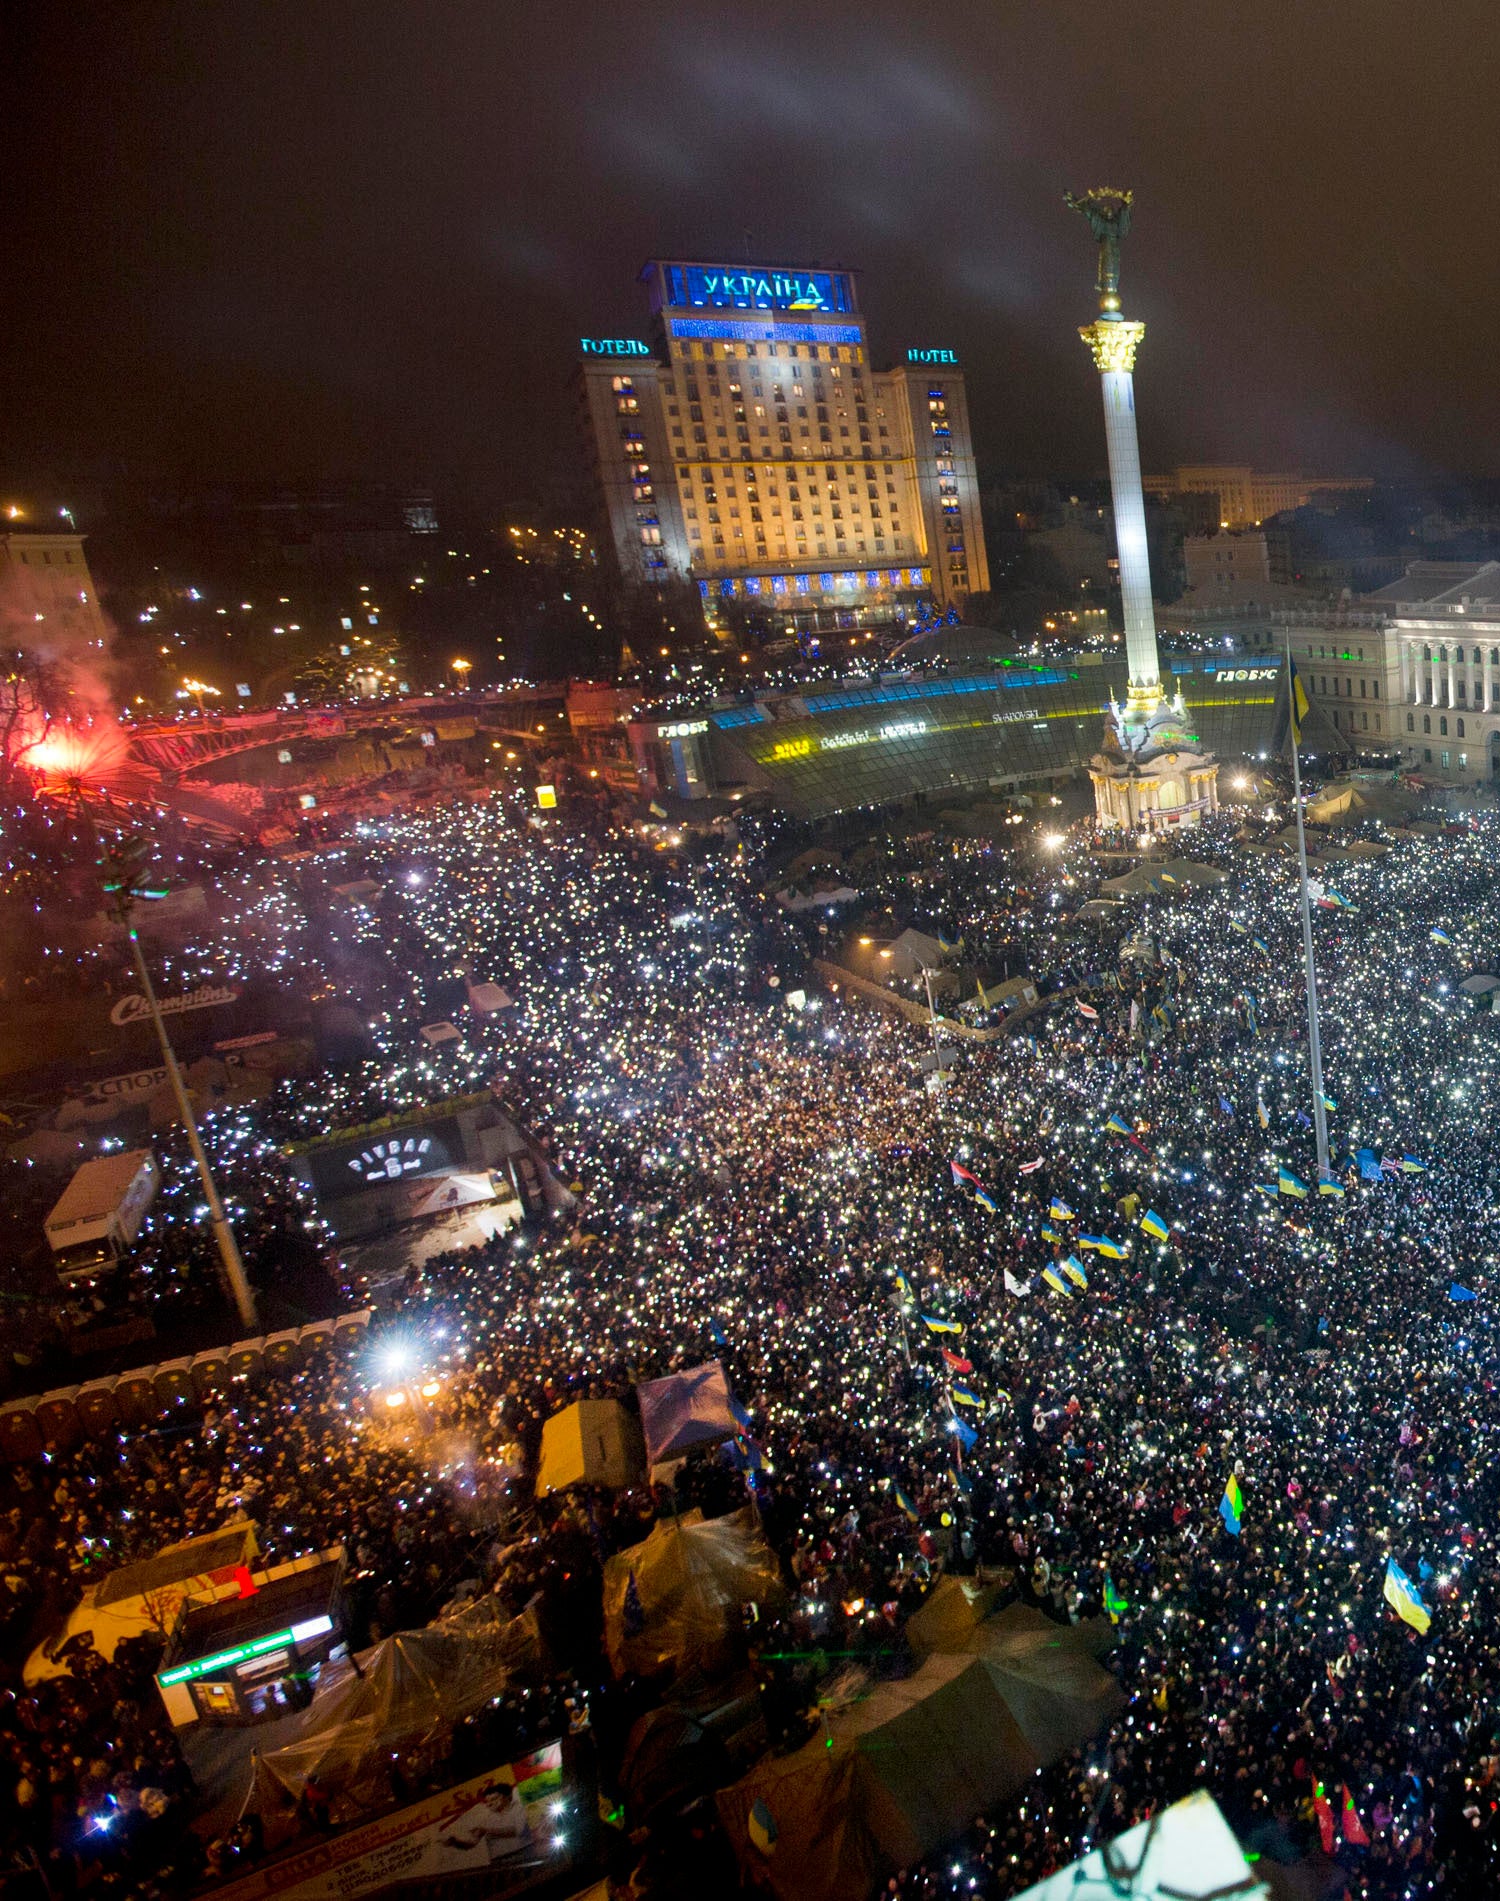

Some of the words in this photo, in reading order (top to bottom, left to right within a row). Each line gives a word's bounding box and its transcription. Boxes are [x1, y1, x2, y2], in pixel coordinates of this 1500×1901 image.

[704, 275, 821, 299] УКРАЇНА
[581, 338, 650, 355] ГОТЕЛЬ
[908, 349, 958, 363] HOTEL
[1216, 669, 1278, 683] ГЛОБУС
[110, 985, 238, 1026] Chmpions
[348, 1138, 431, 1172] PIVBAR
